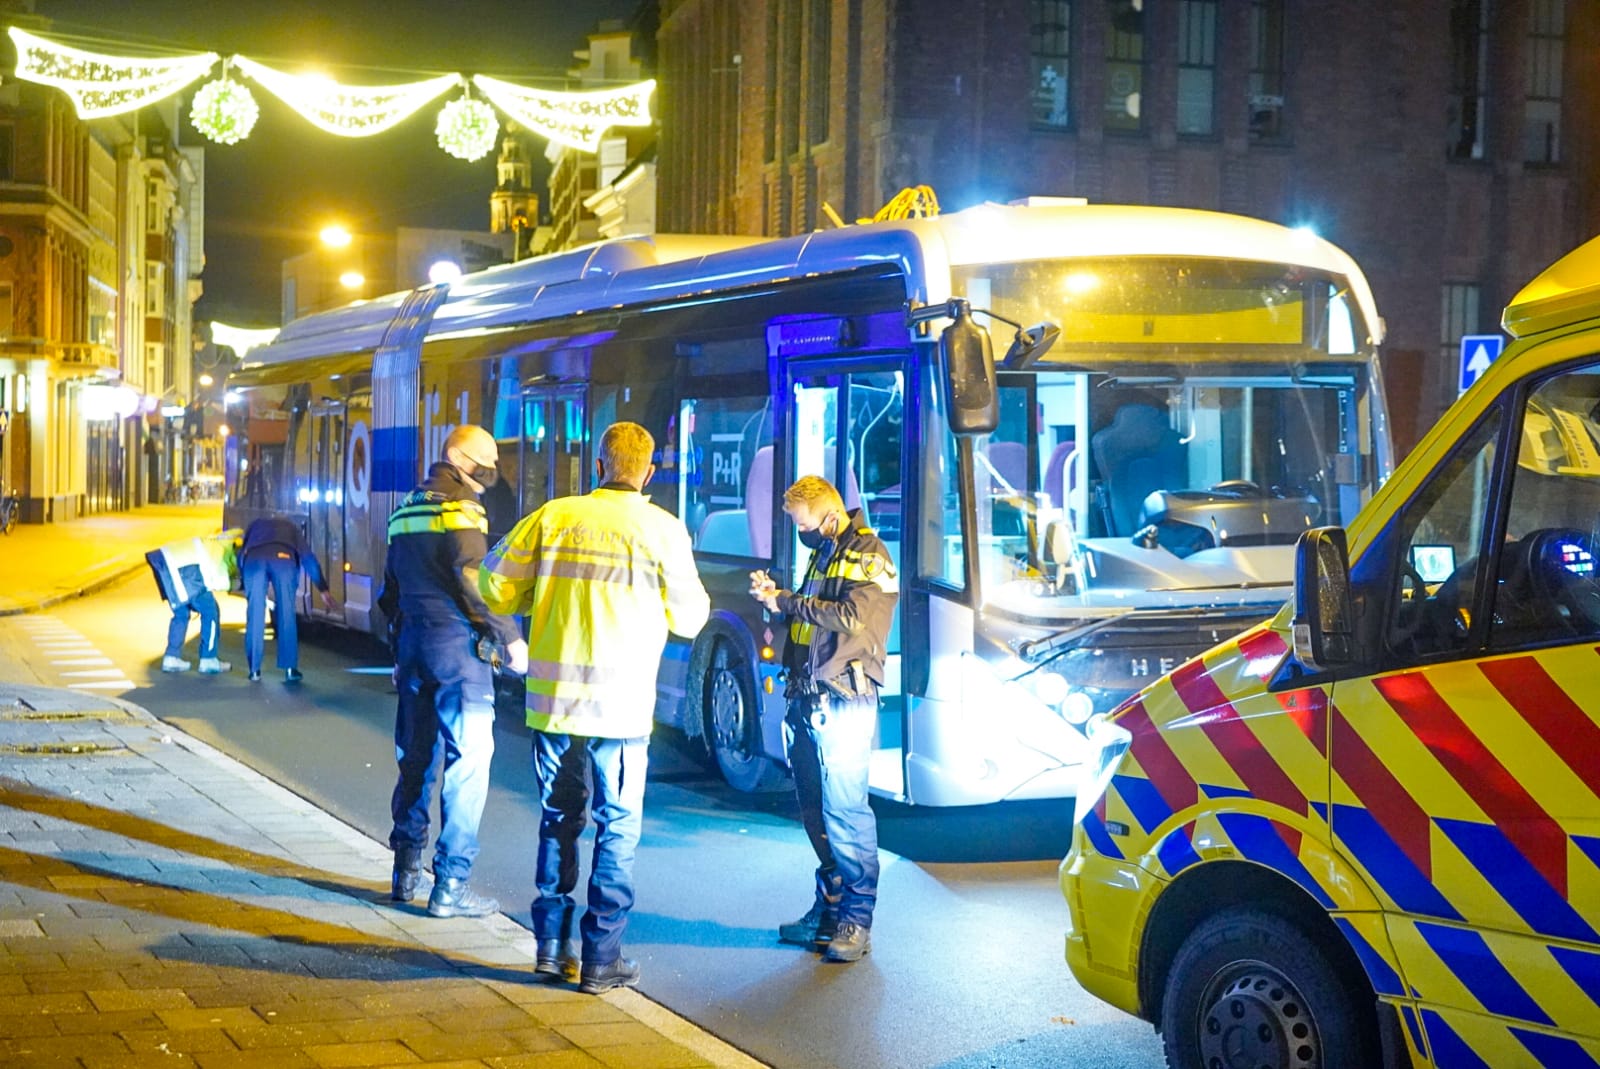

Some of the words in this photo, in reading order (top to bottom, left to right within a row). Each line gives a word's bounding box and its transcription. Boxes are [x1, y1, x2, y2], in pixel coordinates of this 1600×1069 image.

[346, 420, 372, 513] Q
[423, 391, 470, 481] lin
[712, 451, 742, 486] P+R
[1131, 657, 1192, 677] HE
